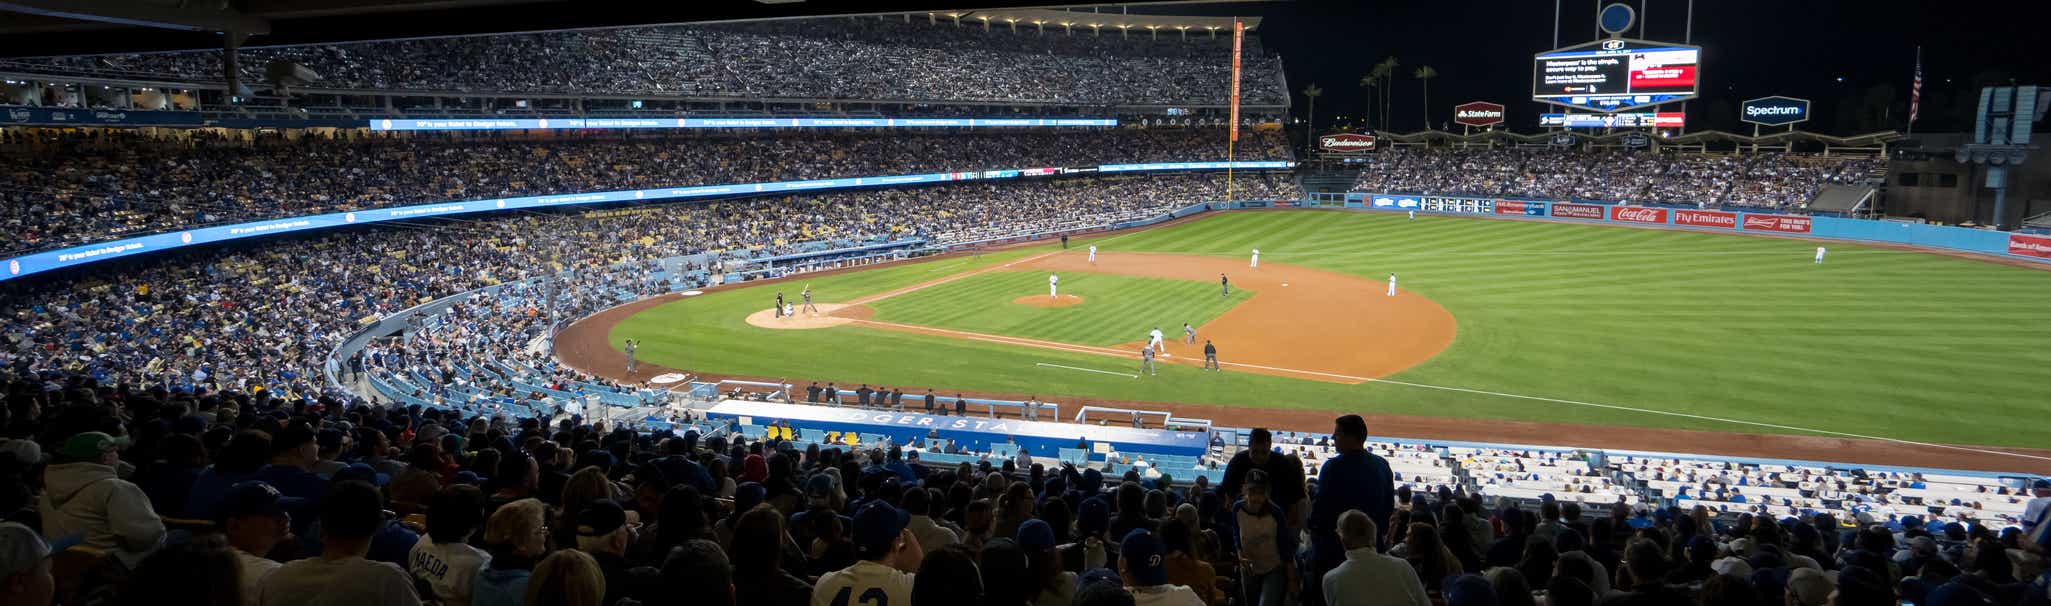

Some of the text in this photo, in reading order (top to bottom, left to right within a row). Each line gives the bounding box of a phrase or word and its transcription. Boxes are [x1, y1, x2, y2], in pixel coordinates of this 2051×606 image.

[1746, 106, 1799, 117] Spectrum
[1323, 138, 1373, 148] Budweiser
[1676, 212, 1735, 224] Fly Emirates
